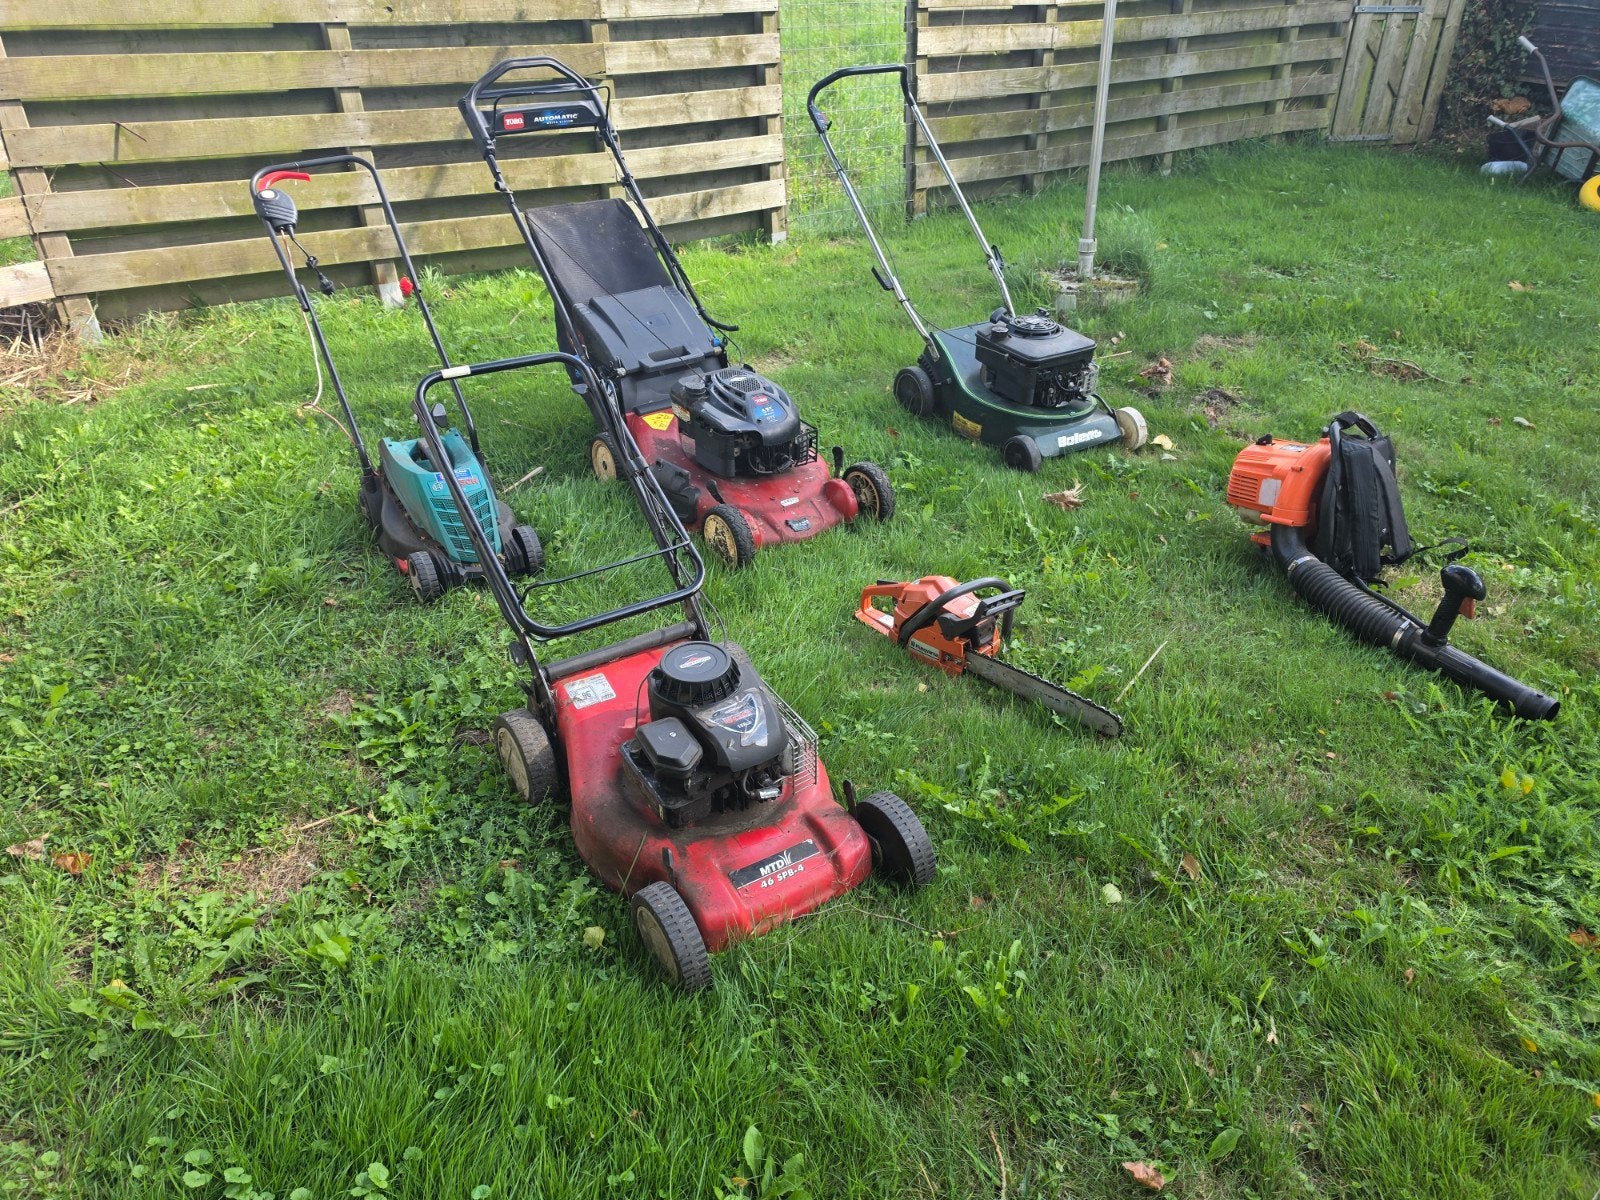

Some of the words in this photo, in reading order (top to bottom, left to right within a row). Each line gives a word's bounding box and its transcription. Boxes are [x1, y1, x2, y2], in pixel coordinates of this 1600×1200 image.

[505, 117, 524, 126] TORO
[534, 113, 579, 123] AUTOMATIC
[759, 859, 785, 877] MTD
[760, 878, 775, 889] 46
[777, 864, 805, 882] SPB-4
